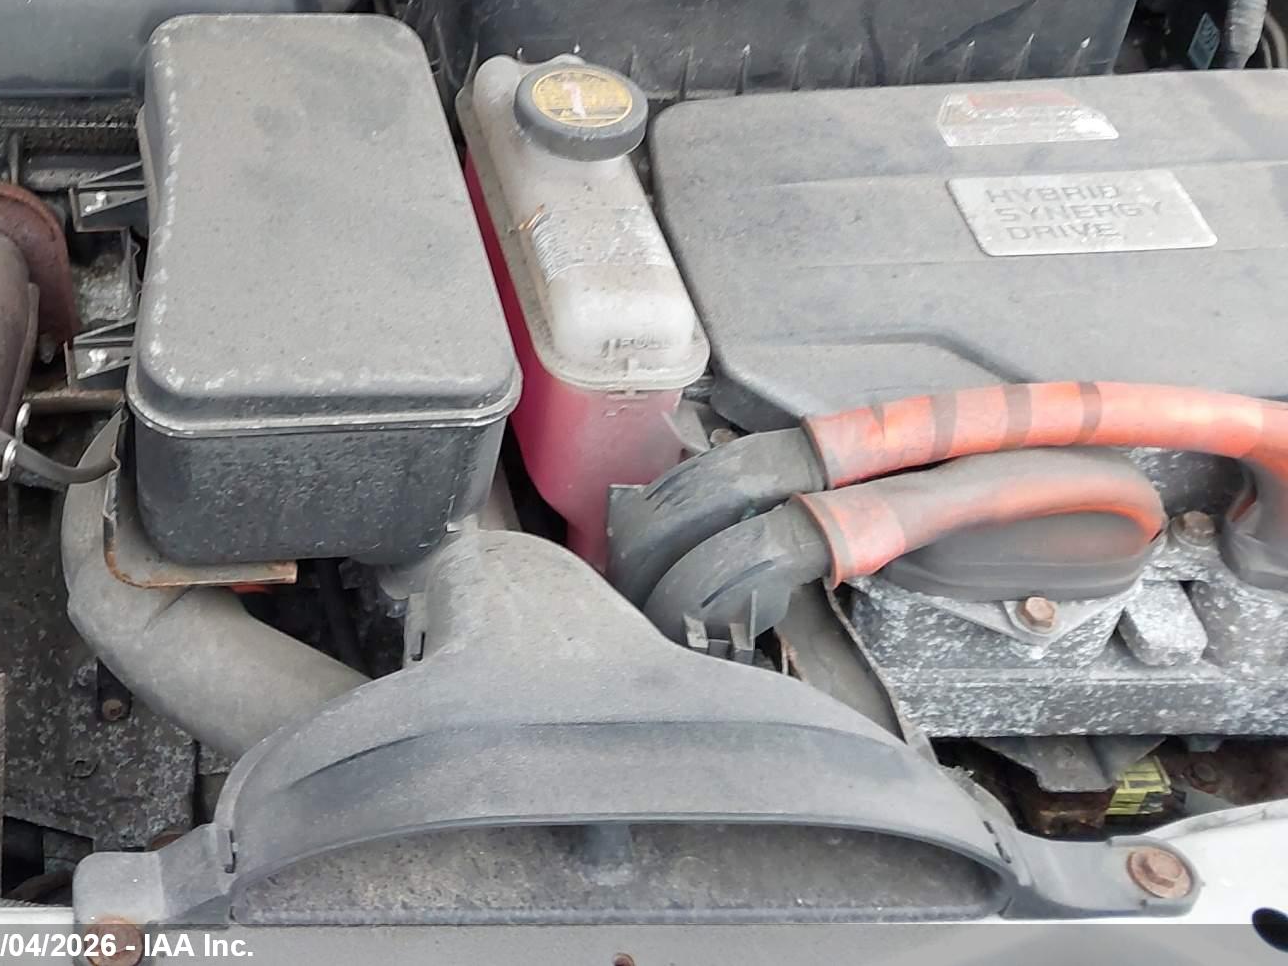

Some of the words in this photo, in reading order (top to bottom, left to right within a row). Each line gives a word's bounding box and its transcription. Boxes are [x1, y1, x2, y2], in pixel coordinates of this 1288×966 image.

[985, 185, 1121, 203] HYBRID
[995, 201, 1162, 223] SYNERGY
[1005, 222, 1121, 241] DRIVE
